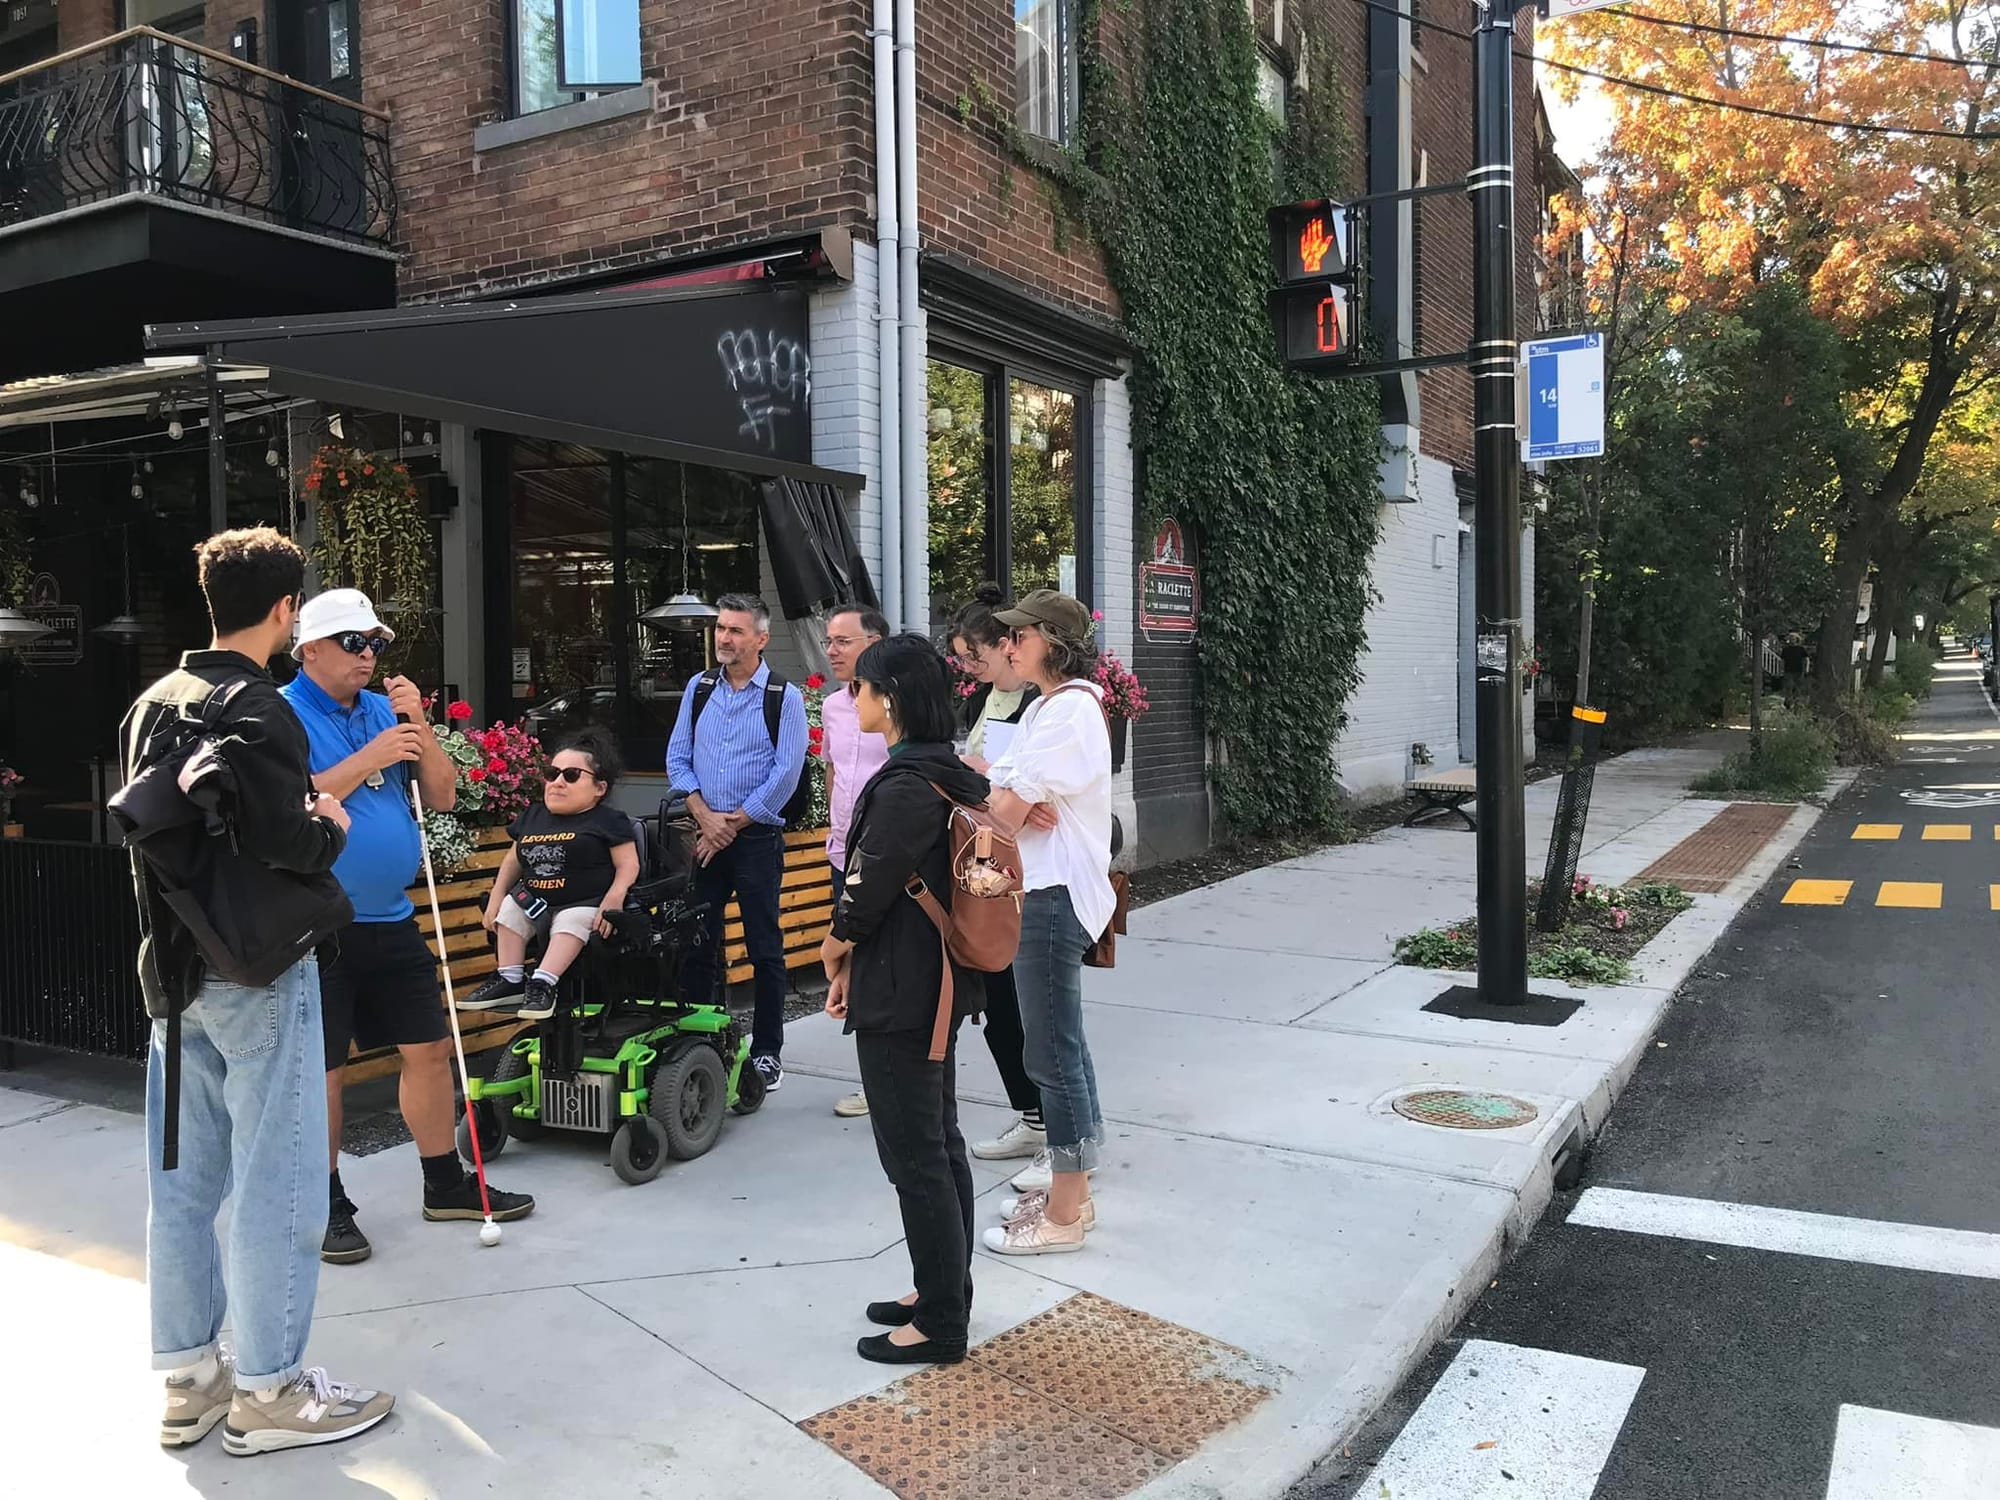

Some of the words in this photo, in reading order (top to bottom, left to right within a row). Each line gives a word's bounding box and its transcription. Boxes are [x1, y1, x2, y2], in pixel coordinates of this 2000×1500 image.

[1317, 296, 1337, 352] 0
[1539, 387, 1557, 404] 14
[1157, 581, 1192, 598] RACLETTE
[521, 832, 576, 843] LEOPARD
[527, 878, 566, 889] COHEN
